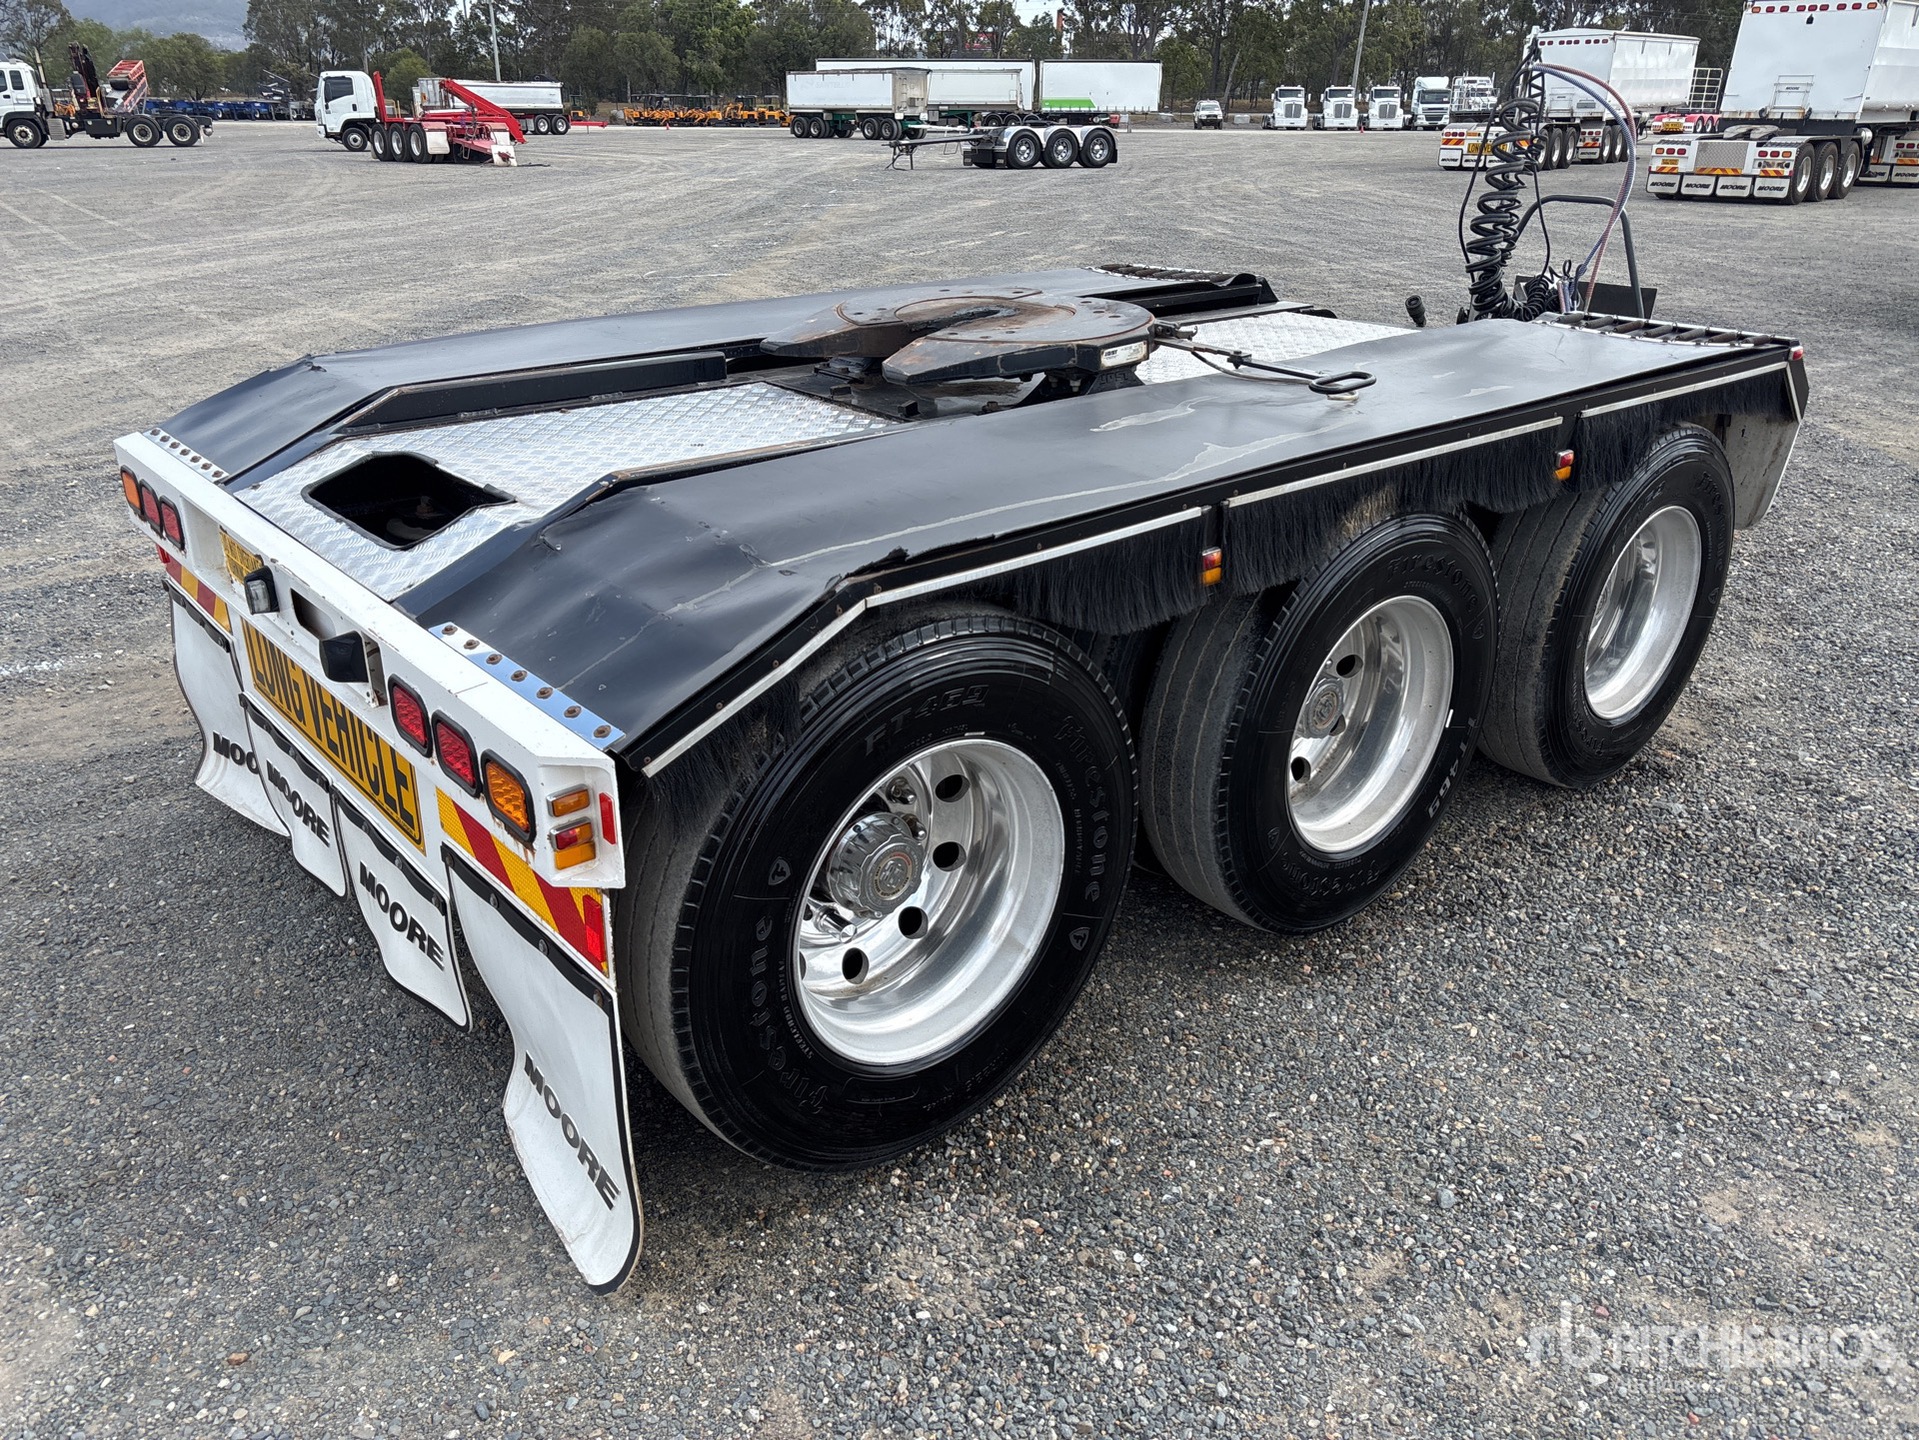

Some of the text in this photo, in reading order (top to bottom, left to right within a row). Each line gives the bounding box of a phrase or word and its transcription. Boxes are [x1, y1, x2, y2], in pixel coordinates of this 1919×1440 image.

[1684, 182, 1712, 190] MOORE
[212, 731, 259, 775] MOO
[247, 623, 415, 829] LONG VEHICLE
[266, 759, 330, 848] MOORE
[1053, 715, 1111, 903] Firestone
[360, 860, 445, 972] MOORE
[749, 914, 829, 1115] Firestone
[524, 1050, 622, 1211] MOORE
